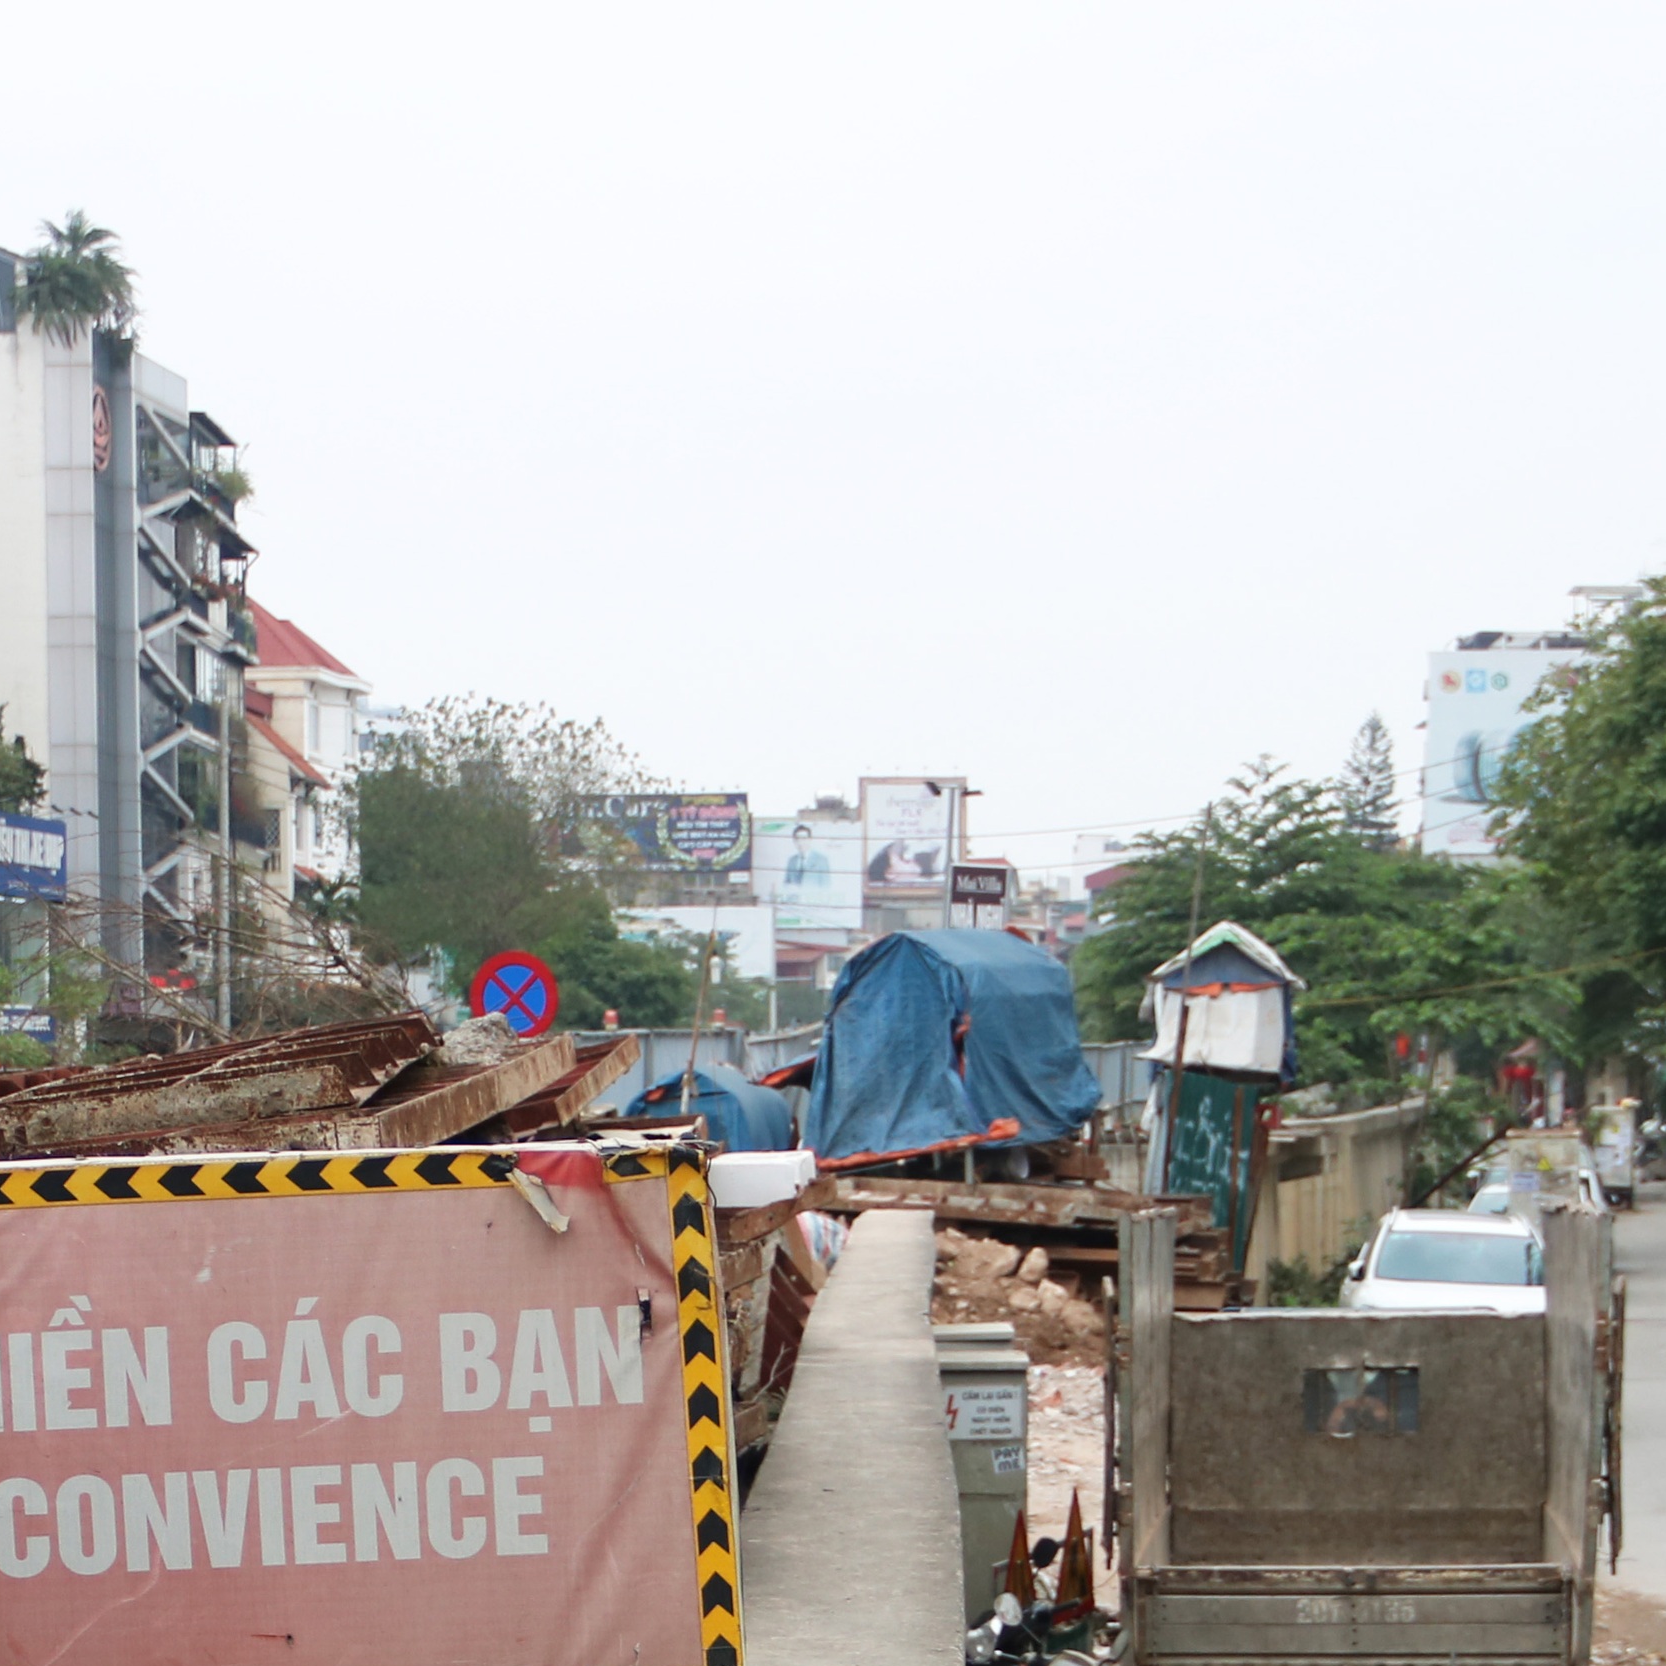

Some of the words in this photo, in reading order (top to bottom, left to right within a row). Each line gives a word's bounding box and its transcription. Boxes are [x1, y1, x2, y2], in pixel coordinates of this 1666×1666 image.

[205, 1297, 404, 1425] CÁC
[438, 1304, 646, 1433] BẠN
[994, 1447, 1021, 1460] PAY
